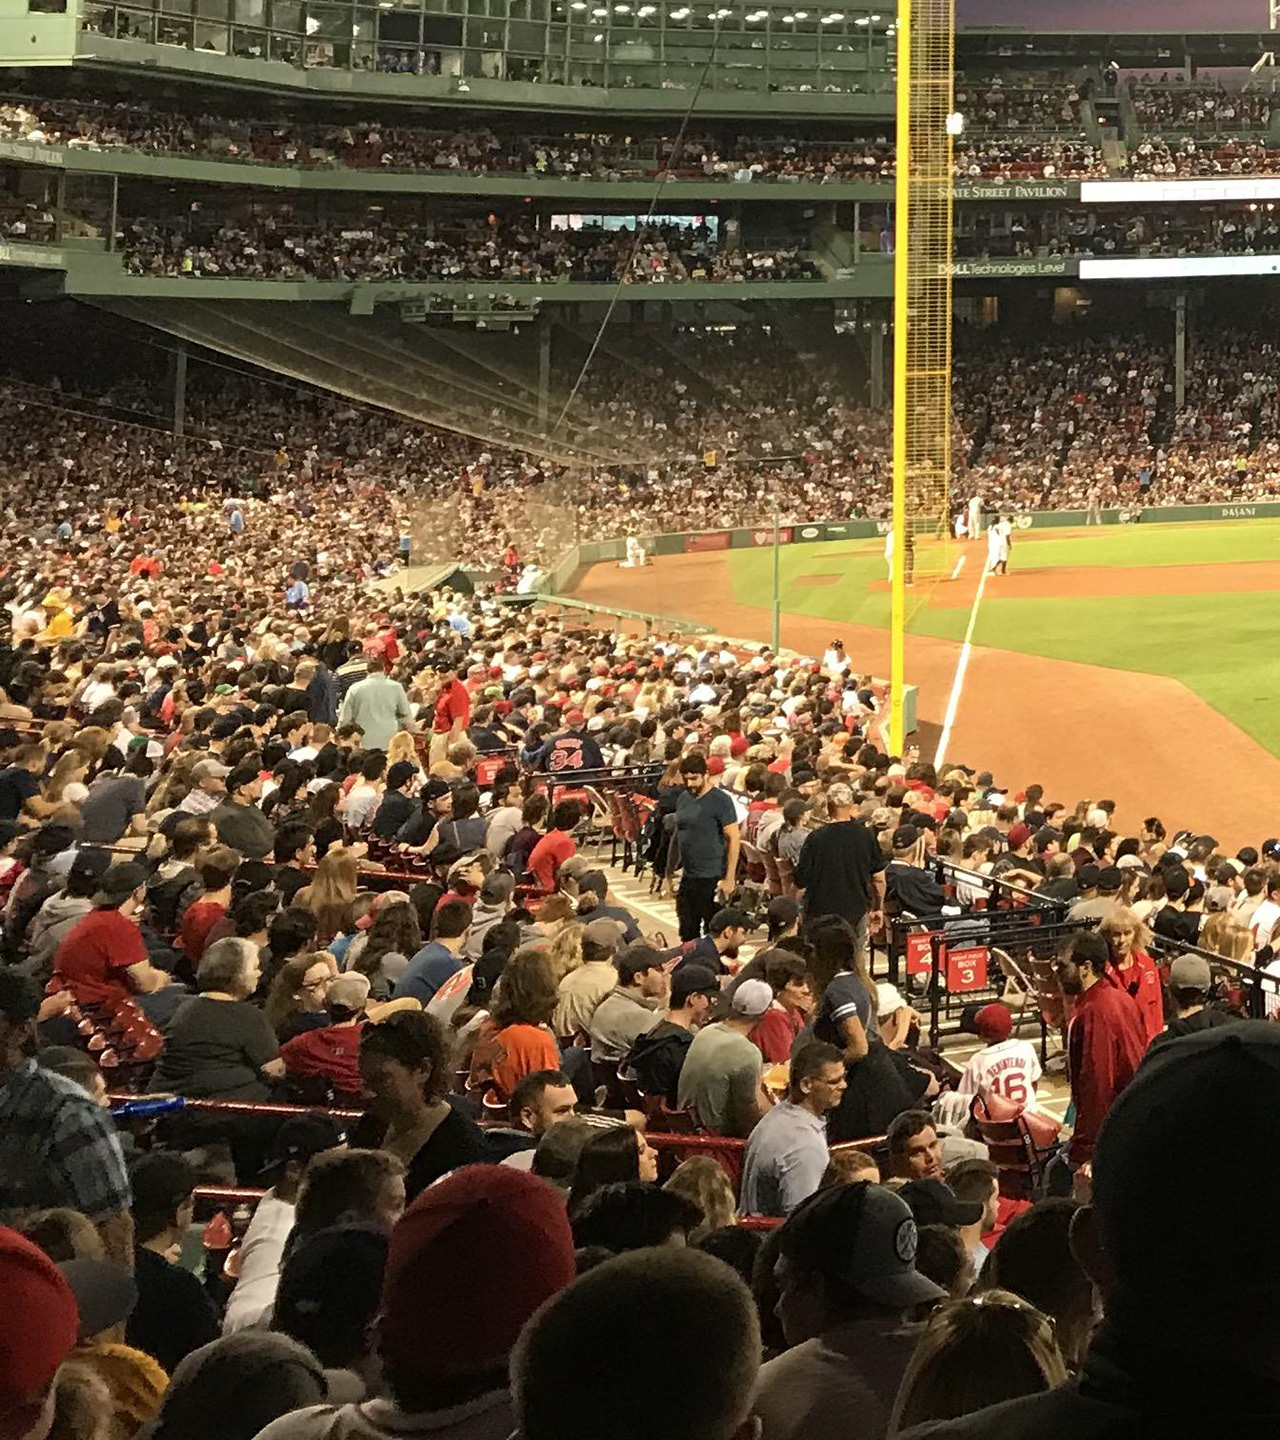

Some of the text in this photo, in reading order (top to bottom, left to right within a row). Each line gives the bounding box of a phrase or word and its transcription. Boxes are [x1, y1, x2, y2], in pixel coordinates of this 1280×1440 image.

[972, 186, 1067, 198] STREET PAVILION
[970, 263, 1036, 275] Technologies
[1038, 262, 1066, 273] Level
[1221, 506, 1257, 517] DASANI
[550, 749, 584, 771] 34
[919, 952, 933, 965] 4
[957, 960, 977, 969] BOX
[961, 969, 975, 984] 3
